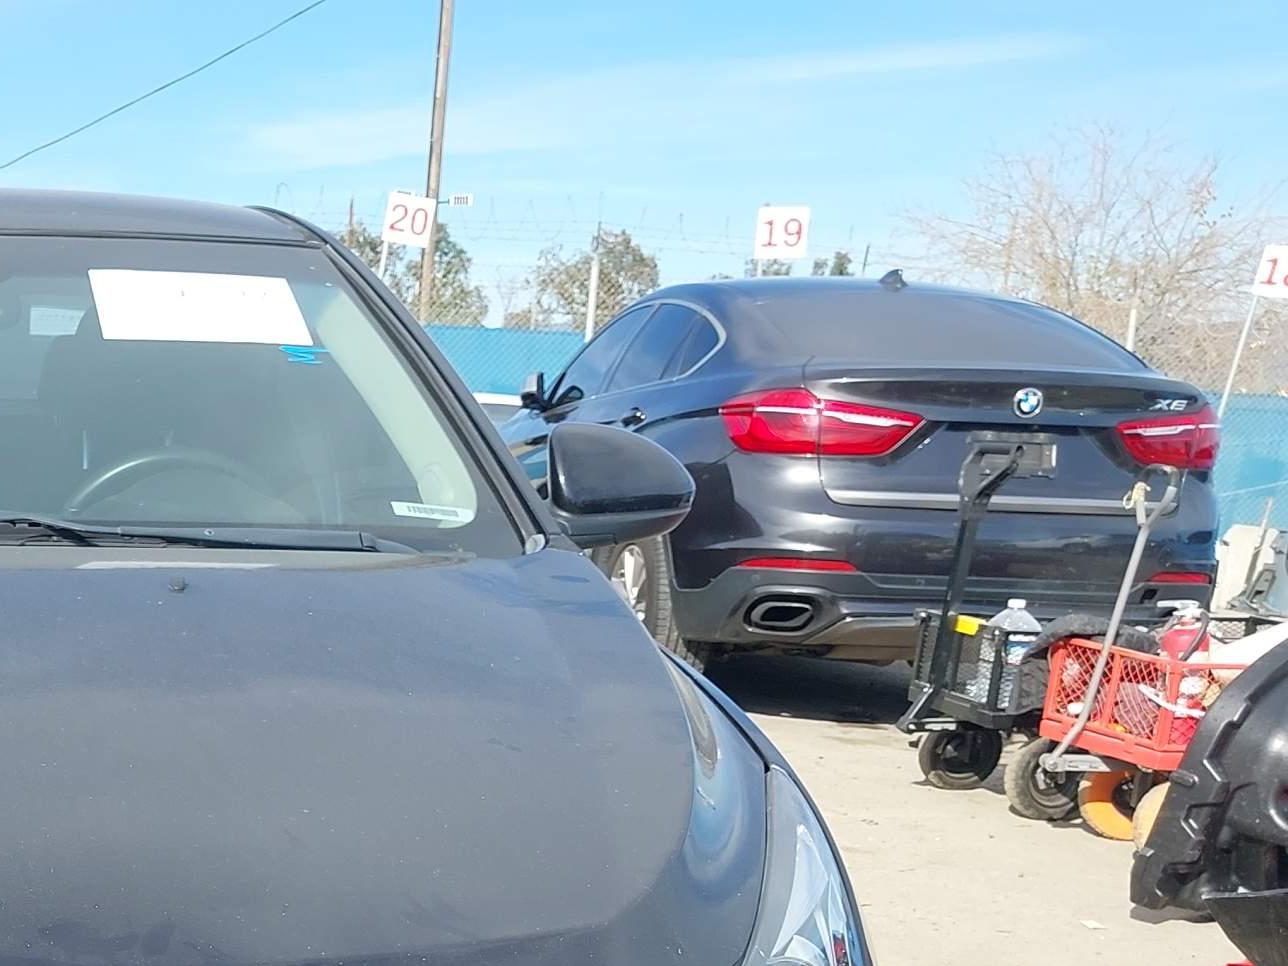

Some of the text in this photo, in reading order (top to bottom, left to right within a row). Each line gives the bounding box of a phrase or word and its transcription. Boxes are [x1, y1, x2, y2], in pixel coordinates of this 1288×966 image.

[389, 204, 428, 236] 20
[761, 218, 802, 247] 19
[1259, 257, 1288, 286] 1
